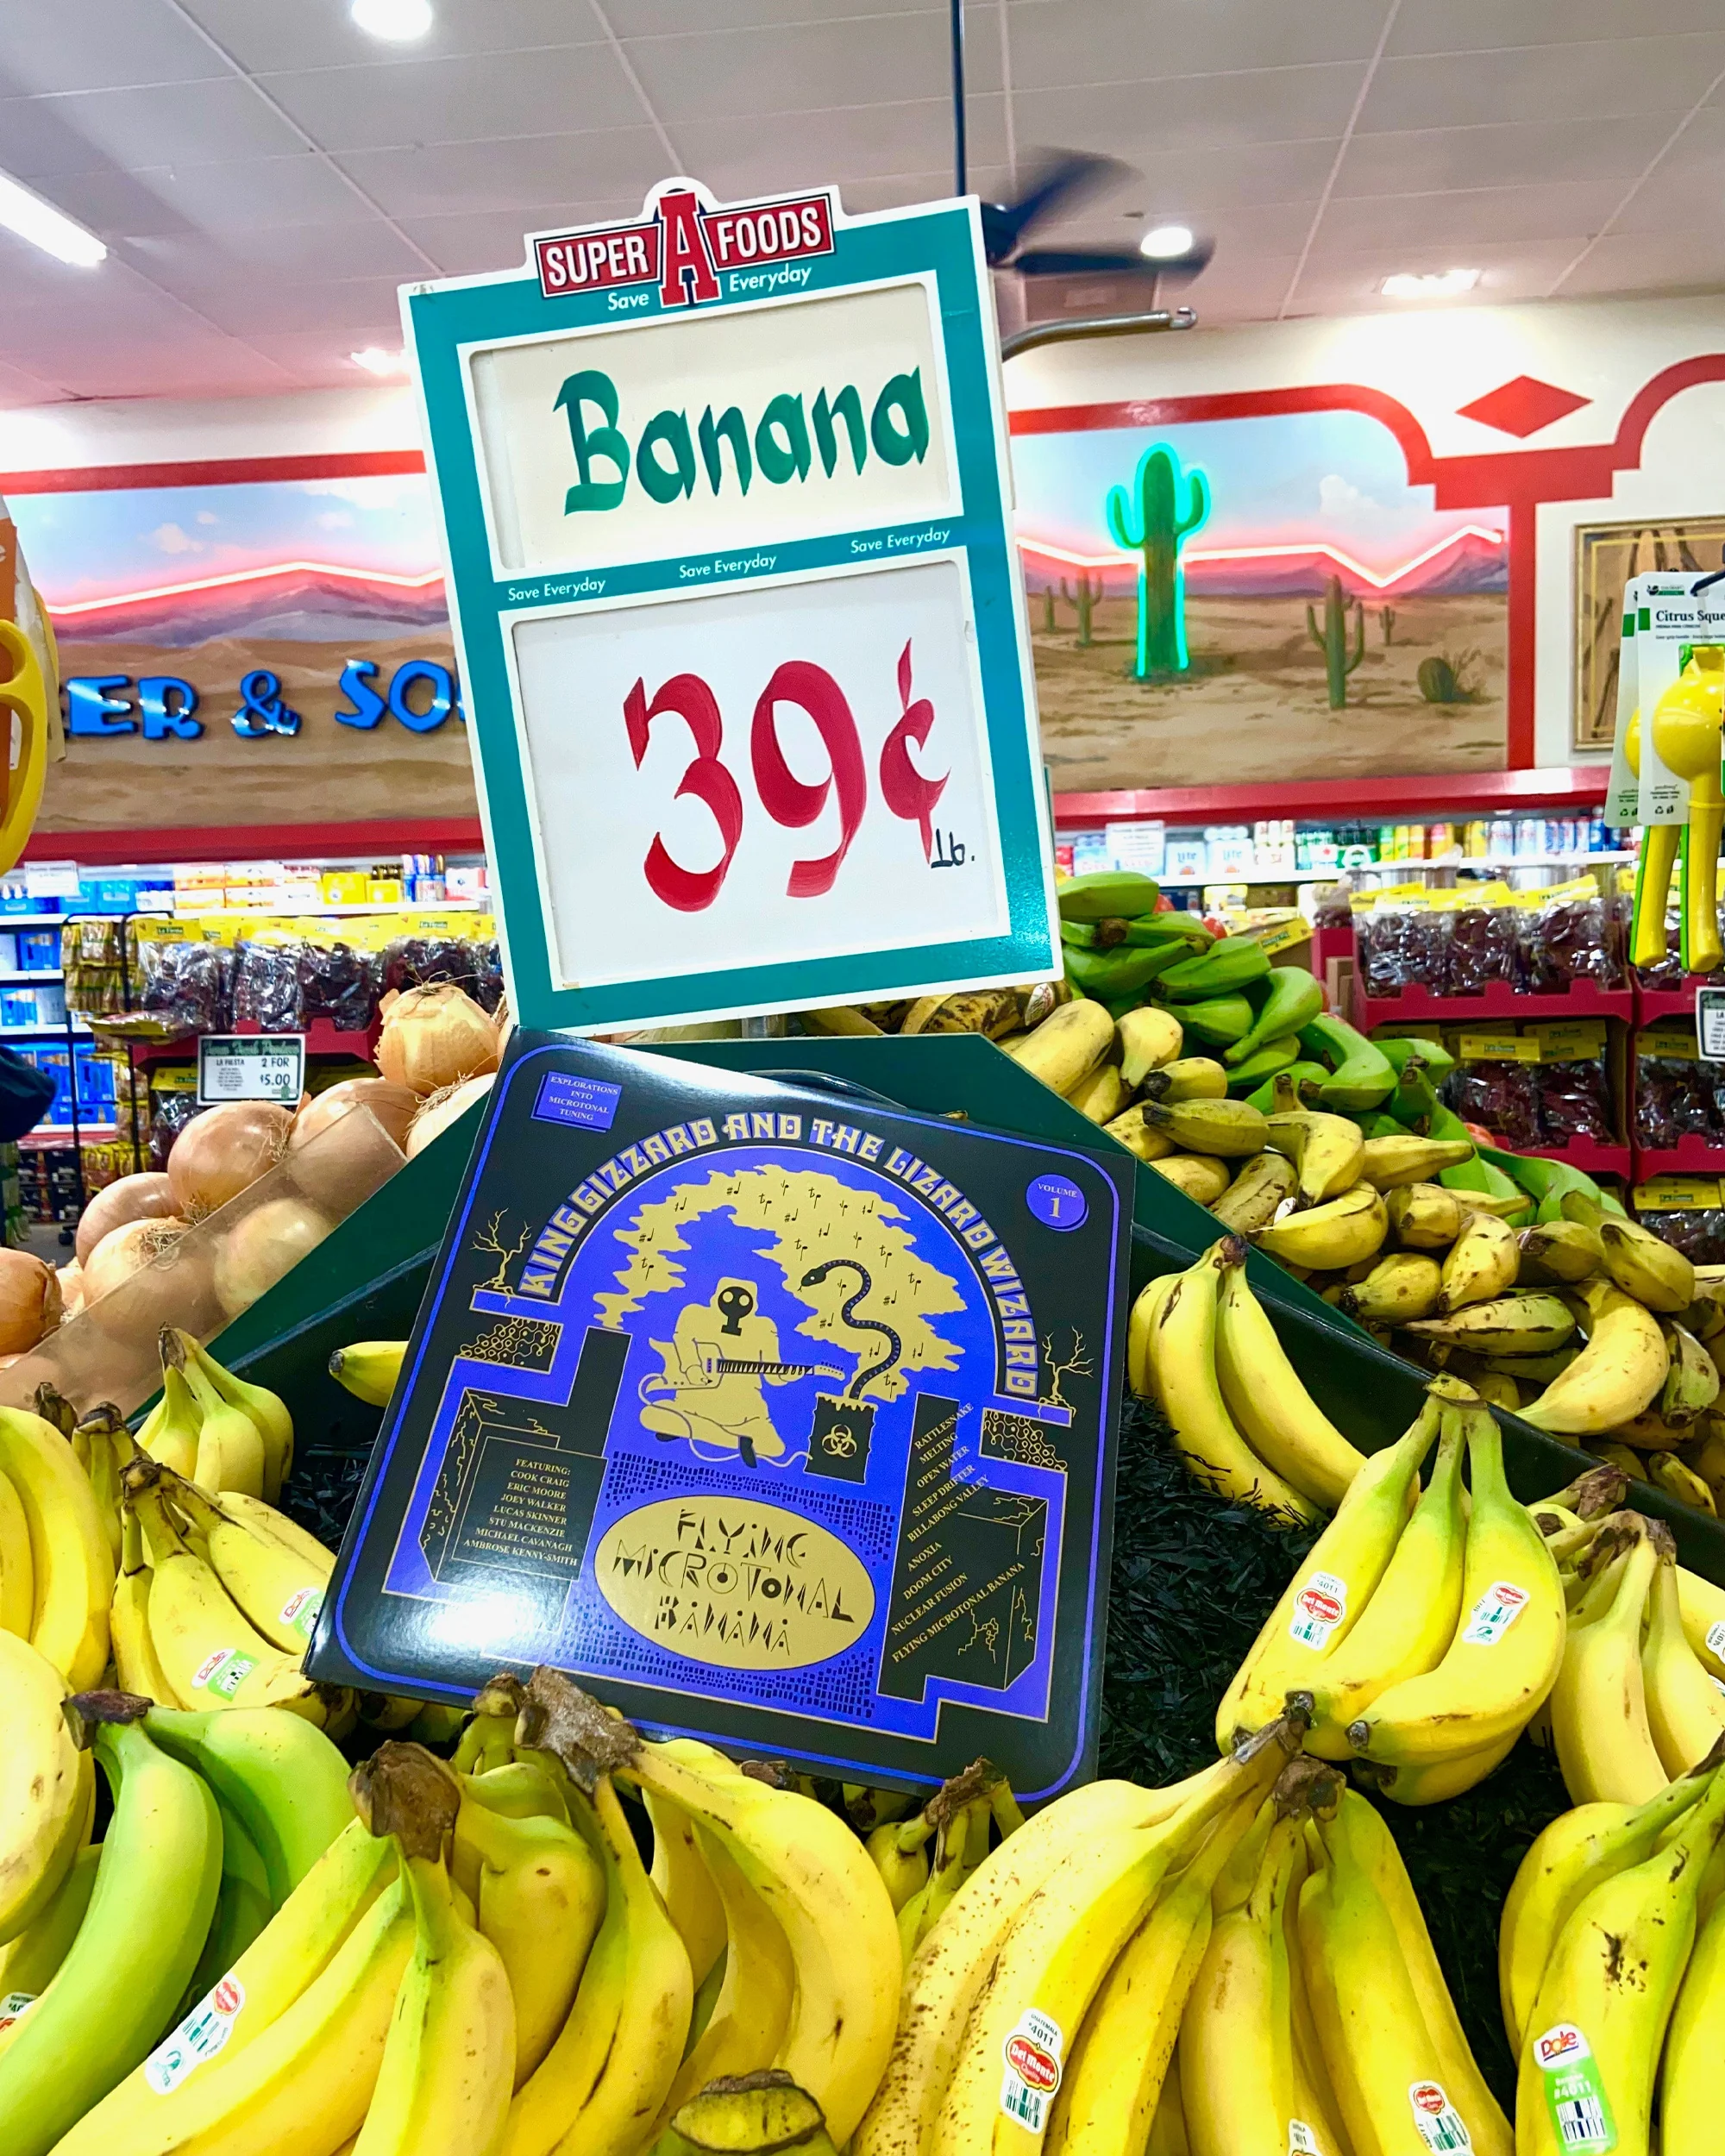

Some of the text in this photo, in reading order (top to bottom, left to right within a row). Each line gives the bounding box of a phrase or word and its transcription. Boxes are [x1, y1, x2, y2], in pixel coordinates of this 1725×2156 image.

[543, 191, 824, 307] SUPER A FOODS
[607, 264, 812, 311] Save Everyday
[553, 366, 929, 517] Banana
[850, 528, 950, 555] Save Everyday
[679, 554, 777, 580] Save Everyday
[507, 578, 605, 602] Save Everyday
[1656, 610, 1694, 621] Citrus
[66, 658, 467, 741] ER & SO
[624, 637, 951, 912] 39¢
[261, 1057, 289, 1068] 2 FOR
[260, 1074, 291, 1086] $5.00
[551, 1076, 618, 1095] EXPLORATIONS
[549, 1096, 609, 1114] MICROTONAL
[571, 1090, 593, 1100] INTO
[560, 1108, 593, 1121] TUNING
[1038, 1182, 1077, 1199] VOLUME
[1049, 1198, 1061, 1219] 1
[519, 1112, 1038, 1395] KING GIZZARD AND THE LIZARD WIZARD
[914, 1402, 974, 1450] RATTLESNAKE
[919, 1432, 958, 1464] MELTING
[511, 1470, 570, 1488] COOK CRAIG
[515, 1458, 571, 1476] FEATURING:
[916, 1445, 970, 1489] OPEN WATER
[500, 1494, 566, 1513] JOEY WALKER
[507, 1482, 567, 1500] ERIC MOORE
[912, 1464, 976, 1517] SLEEP DRIFTER
[493, 1505, 568, 1526] LUCAS SKINNER
[906, 1474, 989, 1542] BILLABONG VALLEY
[475, 1527, 573, 1552] MICHAEL CAVANAGH
[488, 1516, 566, 1538] STU MACKENZIE
[463, 1539, 578, 1566] AMBROSE KENNY-SMITH
[907, 1541, 943, 1572] ANOXIA
[903, 1555, 954, 1600] DOOM CITY
[891, 1572, 969, 1635] NUCLEAR FUSION
[1302, 1594, 1315, 1605] Del
[891, 1562, 1026, 1664] FLYING MICROTONAL BANANA
[1541, 2031, 1577, 2058] Dole
[1011, 2042, 1055, 2083] Del Monte
